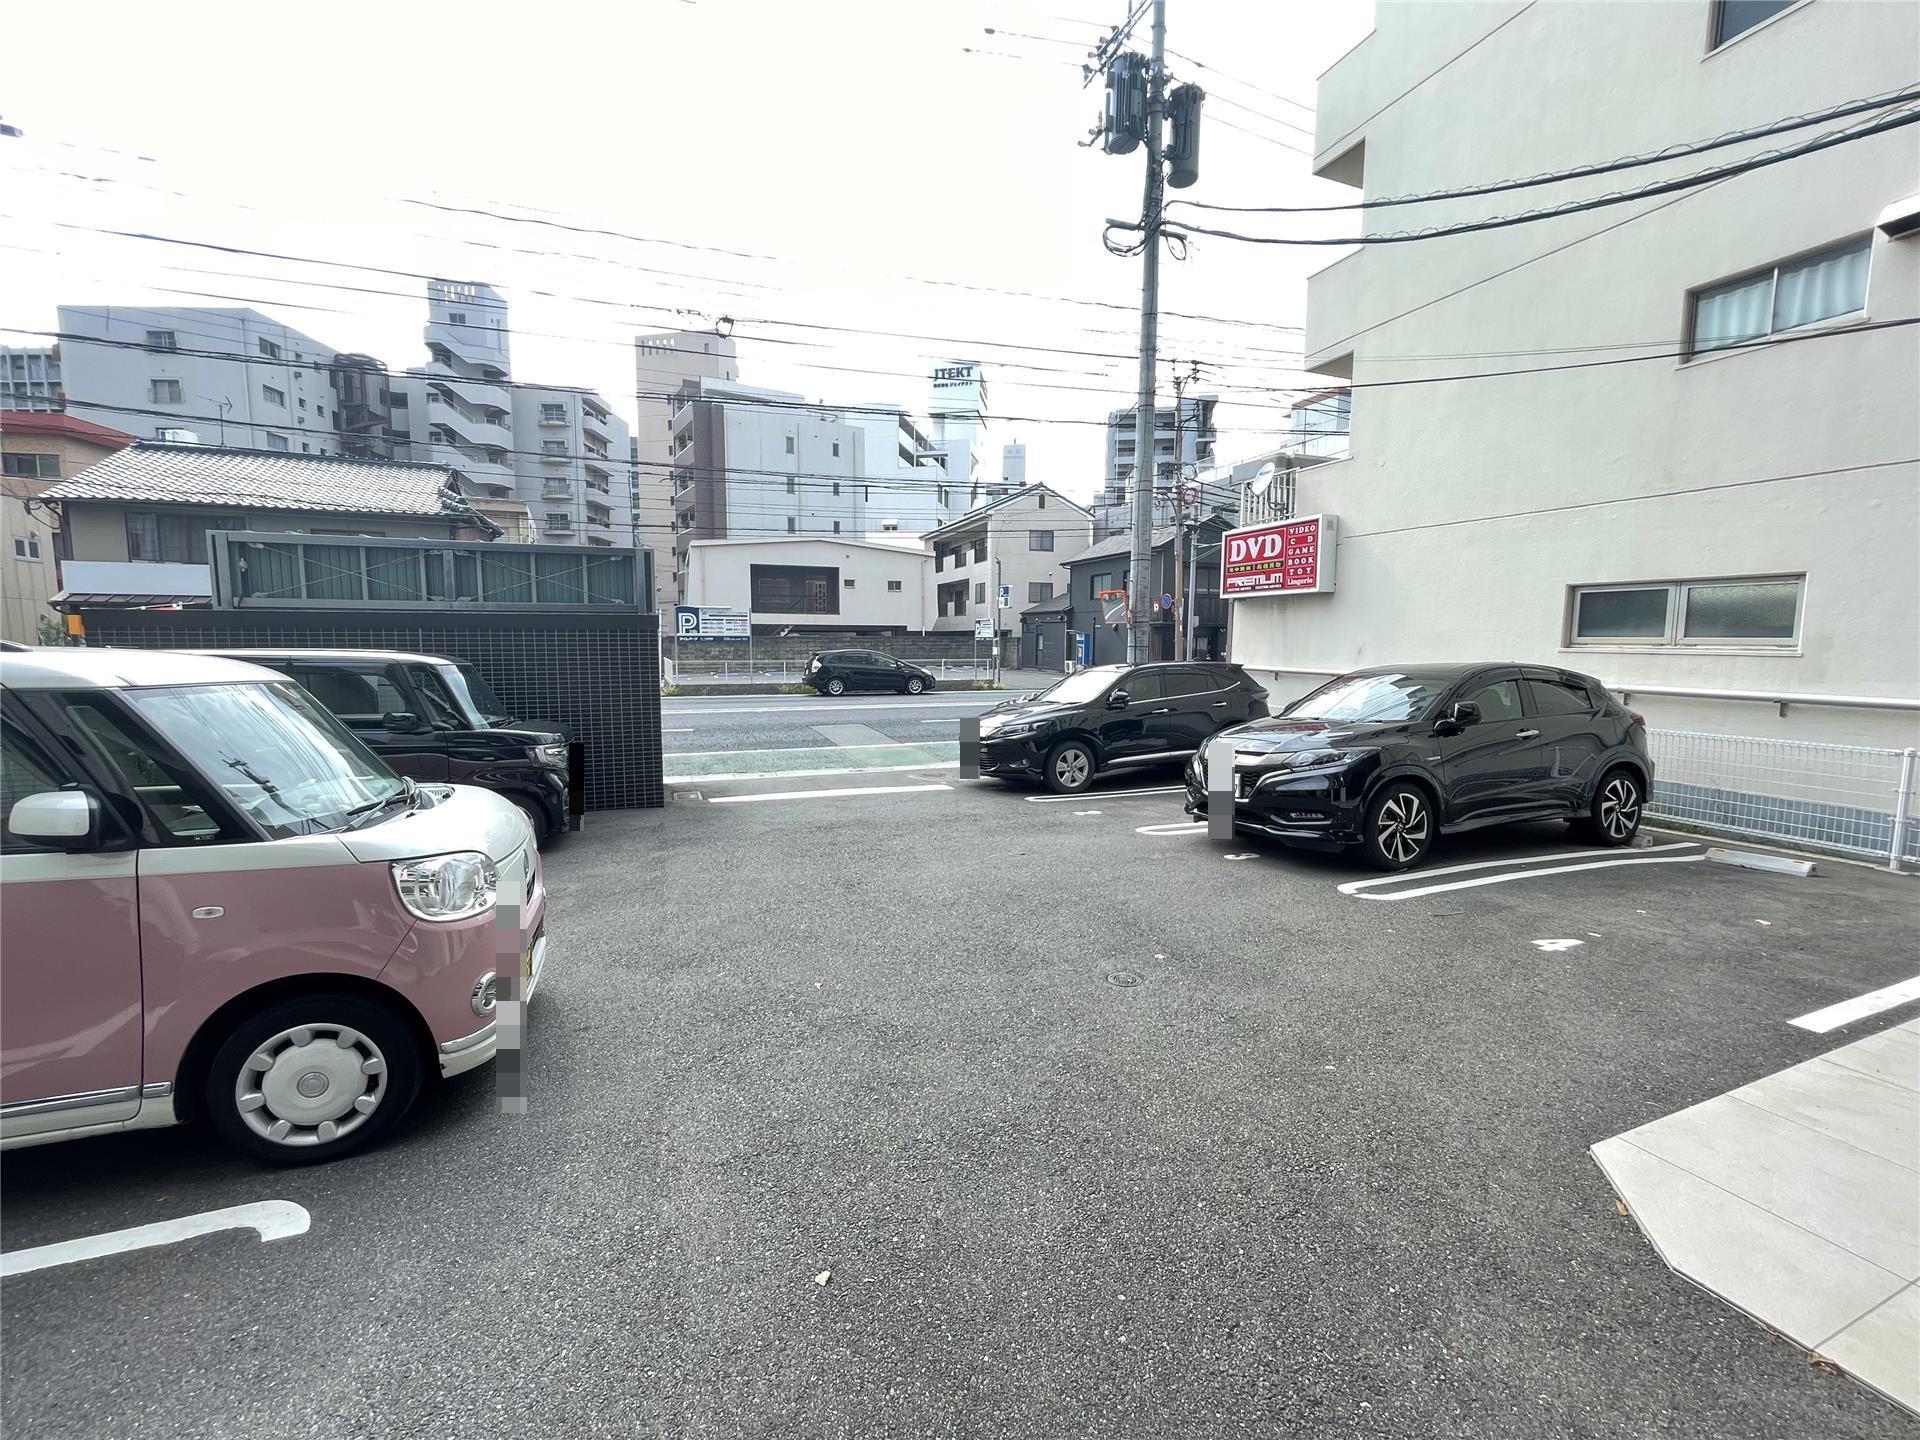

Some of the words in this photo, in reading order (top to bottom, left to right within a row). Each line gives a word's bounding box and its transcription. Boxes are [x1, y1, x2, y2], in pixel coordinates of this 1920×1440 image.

[933, 366, 973, 382] JTEKT
[1289, 525, 1316, 535] VIDEO
[1229, 533, 1283, 562] DVD
[1288, 545, 1315, 555] GAME
[1287, 556, 1314, 566] BOOK
[1288, 567, 1313, 576] TOY
[1287, 577, 1313, 586] Lingerie
[678, 612, 698, 634] P
